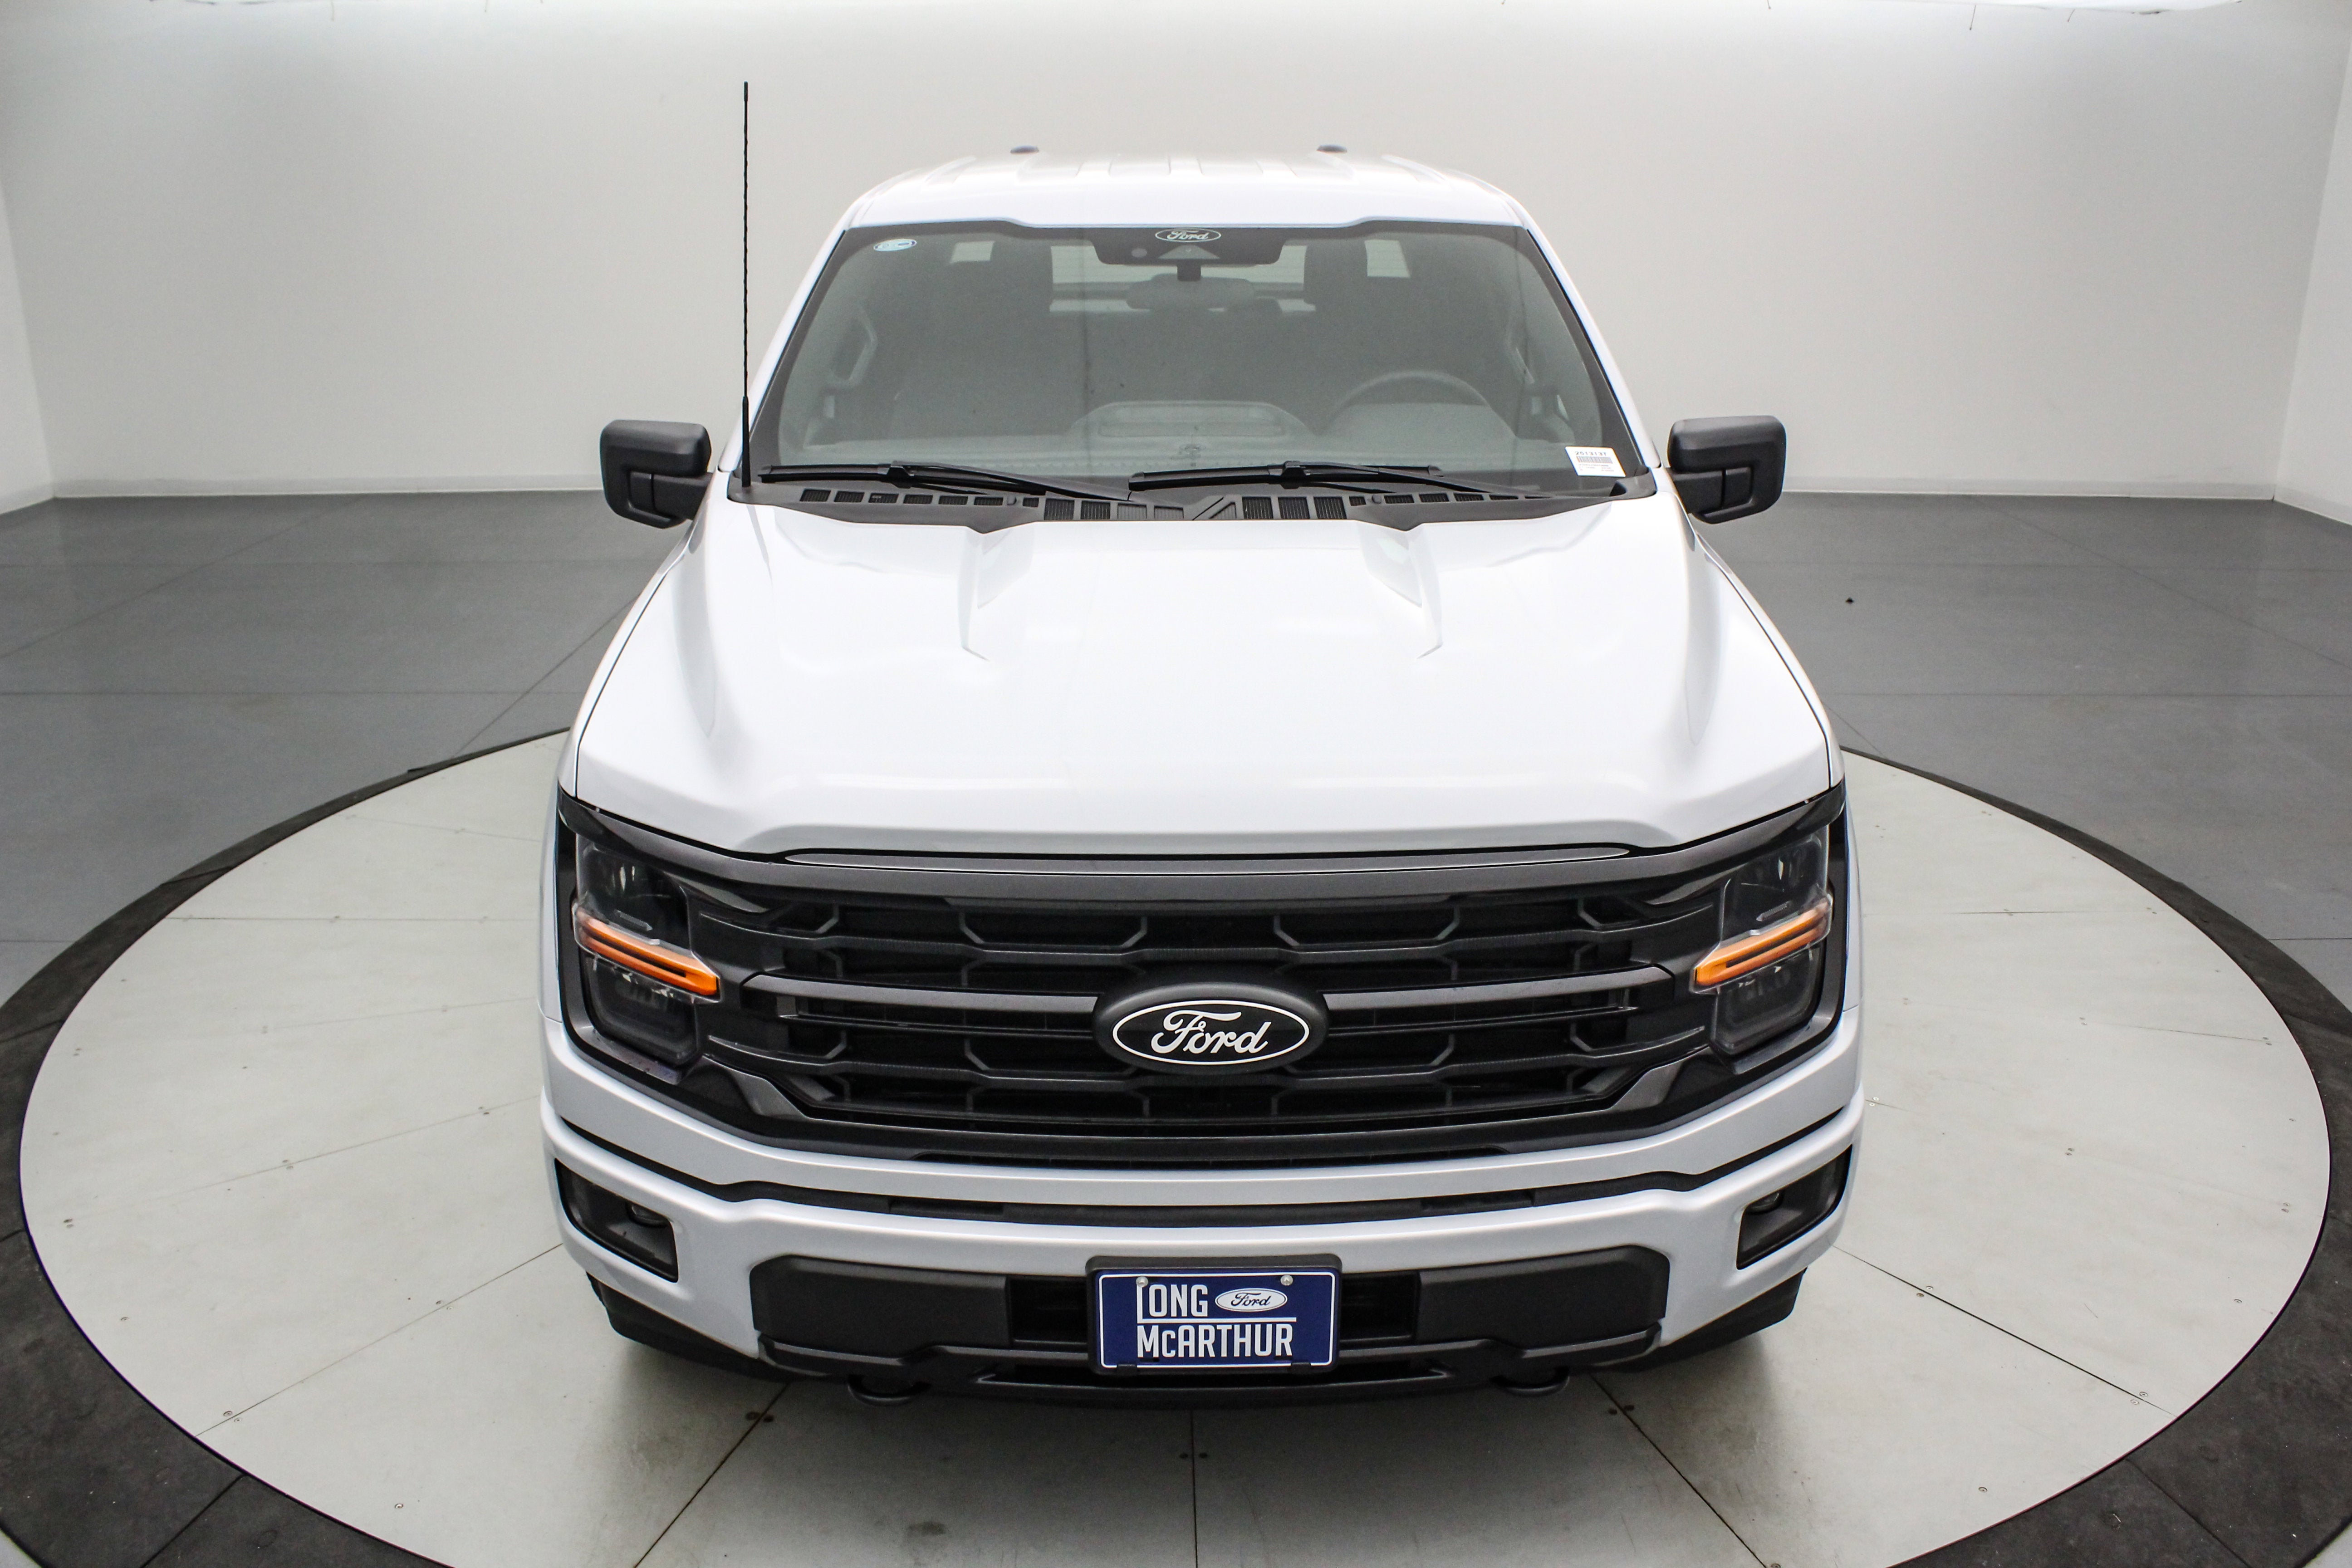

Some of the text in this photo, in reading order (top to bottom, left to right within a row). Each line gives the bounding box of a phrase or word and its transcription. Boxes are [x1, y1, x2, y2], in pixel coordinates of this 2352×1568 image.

[1166, 230, 1209, 240] Ford
[1151, 1009, 1272, 1054] Ford
[1137, 1284, 1273, 1323] LONG Ford
[1137, 1323, 1293, 1358] McARTHUR
